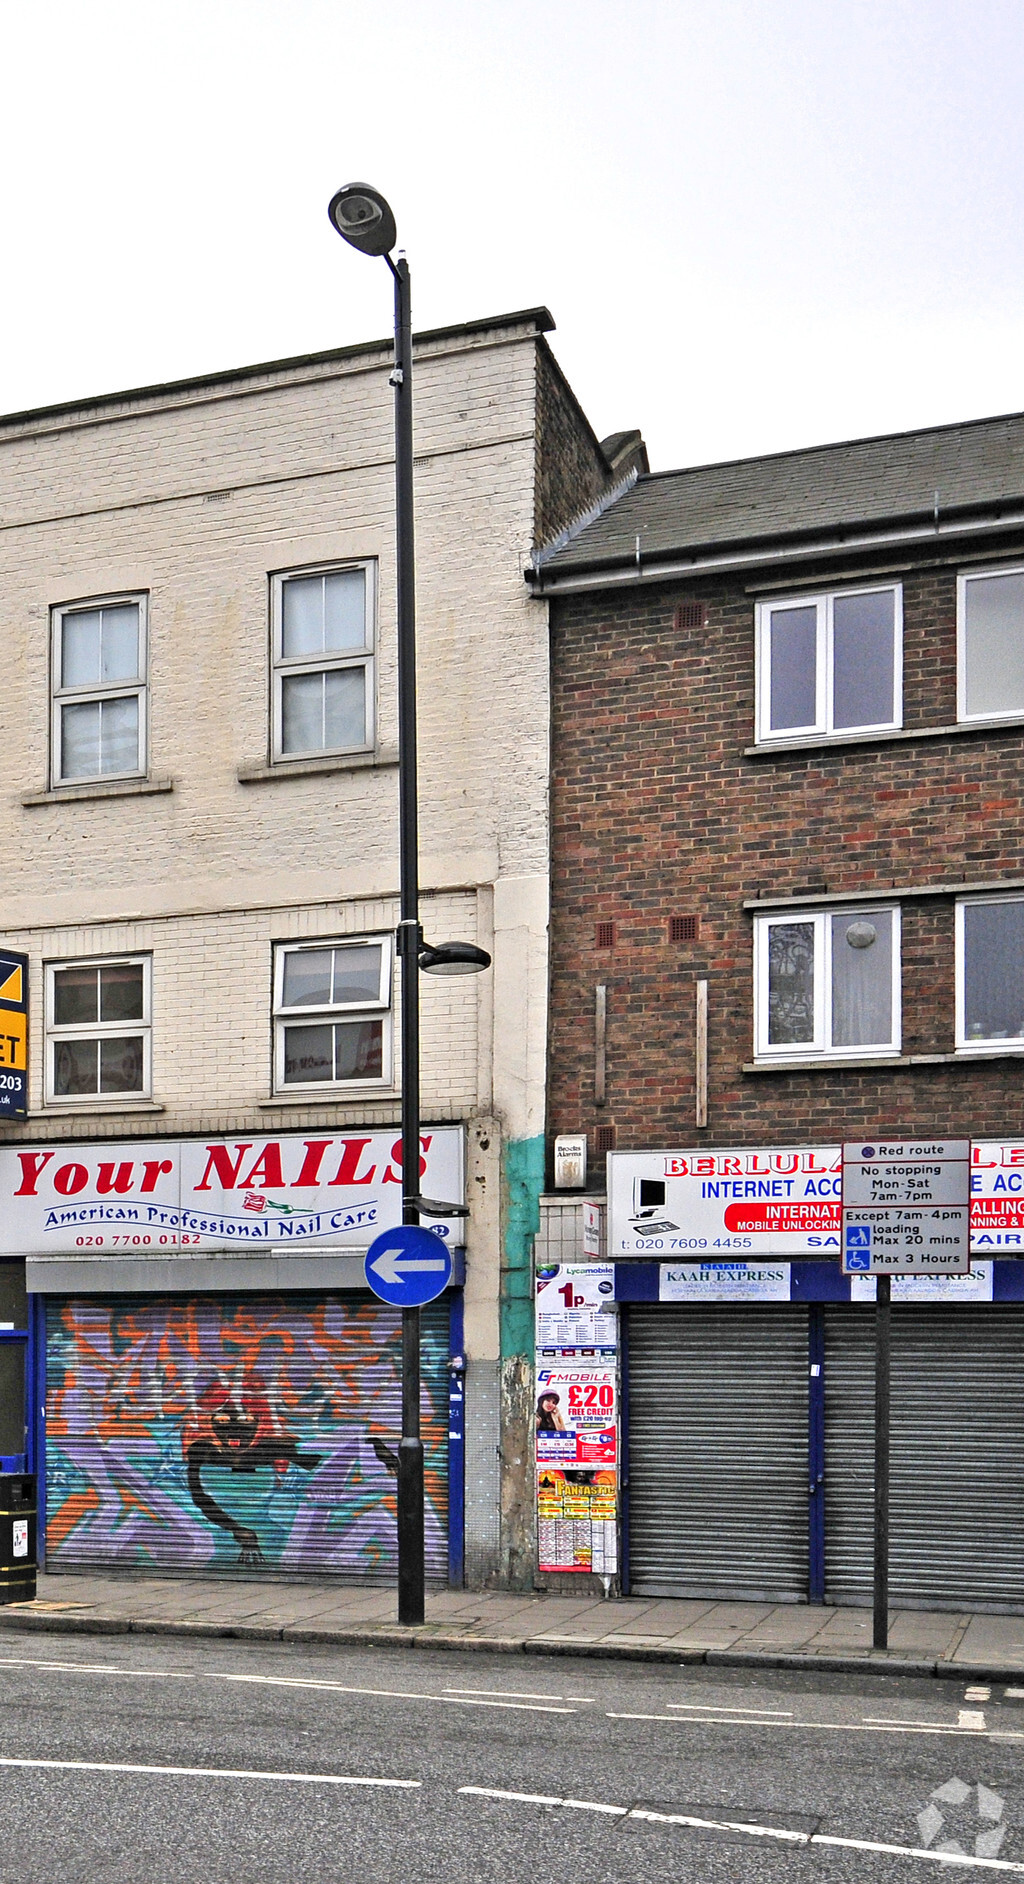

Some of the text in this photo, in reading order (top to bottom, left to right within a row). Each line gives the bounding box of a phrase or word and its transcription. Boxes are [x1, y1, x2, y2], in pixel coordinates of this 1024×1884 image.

[879, 1145, 944, 1156] Red route
[13, 1135, 433, 1196] Your NAILS
[861, 1165, 941, 1176] No stopping
[872, 1178, 930, 1189] Mon-Sat
[993, 1173, 1024, 1192] AC
[702, 1180, 795, 1198] INTERNET
[870, 1190, 932, 1201] 7am-7pm
[45, 1205, 378, 1237] American Professional Nail Care
[846, 1211, 890, 1221] Except
[1010, 1217, 1019, 1226] &
[737, 1220, 779, 1231] MOBILE
[873, 1225, 920, 1235] loading
[75, 1234, 201, 1246] 020 7700 0182
[635, 1239, 664, 1249] 020
[669, 1238, 707, 1249] 7609
[712, 1237, 752, 1248] 4455
[873, 1235, 961, 1245] Max 20 mins
[873, 1254, 960, 1263] Max 3 Hours
[566, 1267, 613, 1275] Lycamobile
[667, 1270, 784, 1281] KAAH EXPRESS
[557, 1373, 612, 1381] MOBILE
[568, 1384, 614, 1407] £20
[568, 1408, 614, 1416] FREE CREDIT
